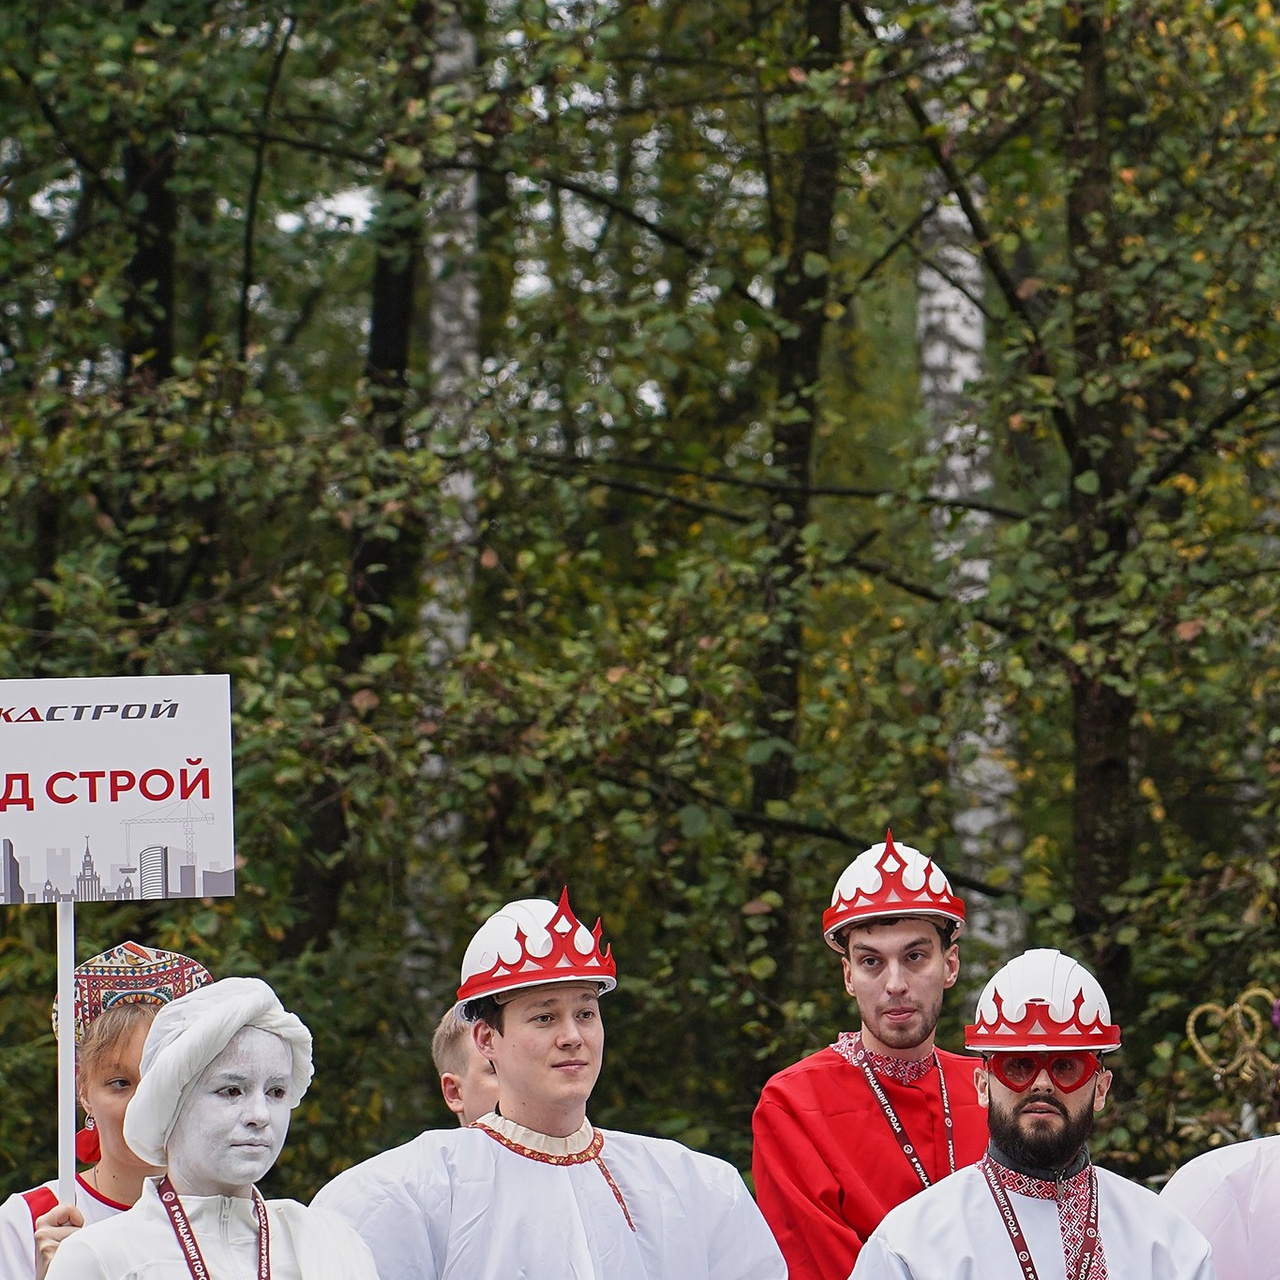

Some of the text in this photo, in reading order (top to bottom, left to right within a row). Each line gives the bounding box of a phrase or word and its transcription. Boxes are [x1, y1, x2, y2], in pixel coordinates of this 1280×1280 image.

[46, 757, 210, 805] СТРОЙ
[865, 1067, 888, 1105] ФУНДАМЕНТ
[884, 1105, 902, 1134] ГОРОДА
[170, 1204, 180, 1212] Я
[986, 1168, 1008, 1207] ФУНДАМЕНТ
[1003, 1206, 1019, 1238] ГОРОДА
[173, 1211, 199, 1260] ФУНДАМЕНТ
[260, 1228, 268, 1279] ФУНДАМЕНТ
